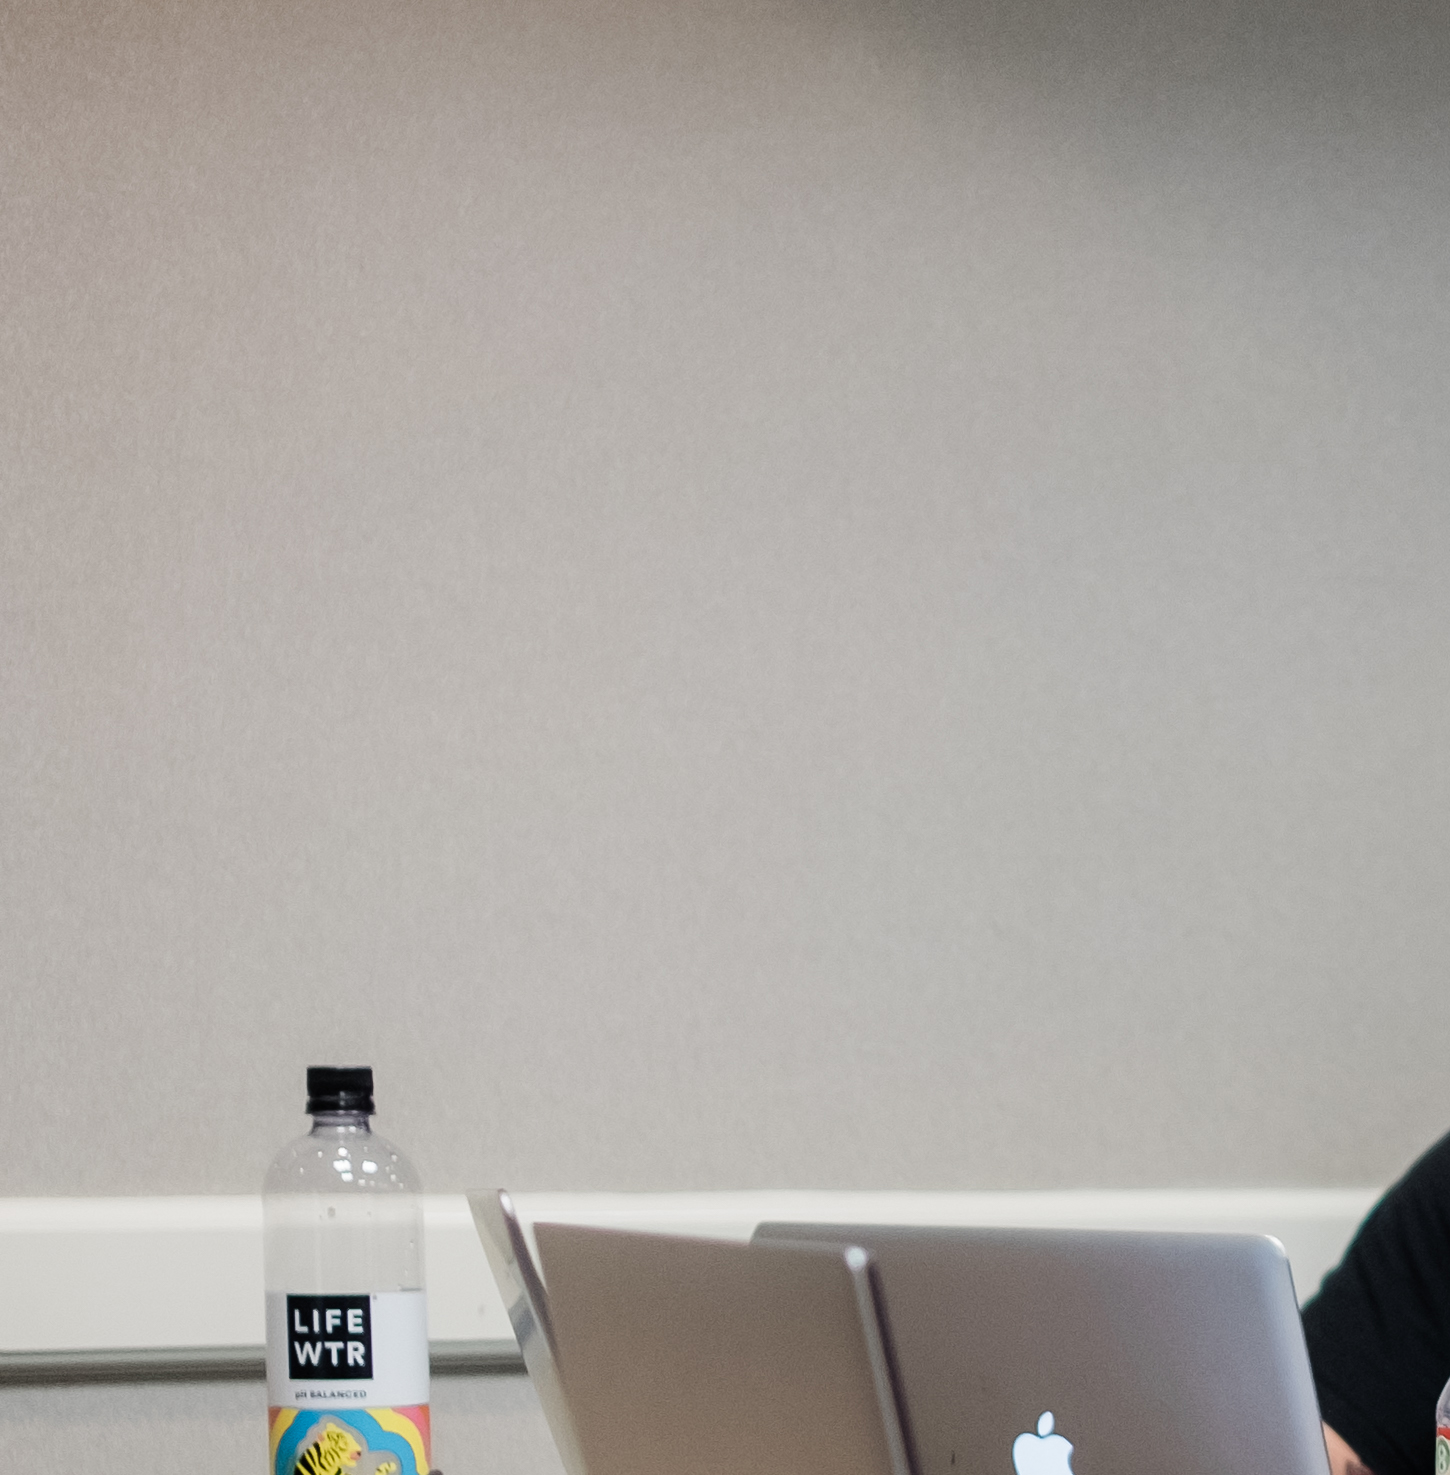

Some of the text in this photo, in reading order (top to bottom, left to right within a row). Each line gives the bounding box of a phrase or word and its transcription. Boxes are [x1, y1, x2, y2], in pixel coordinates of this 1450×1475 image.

[294, 1308, 364, 1334] LIFE
[293, 1341, 366, 1367] WTR
[310, 1389, 367, 1399] BALANCED
